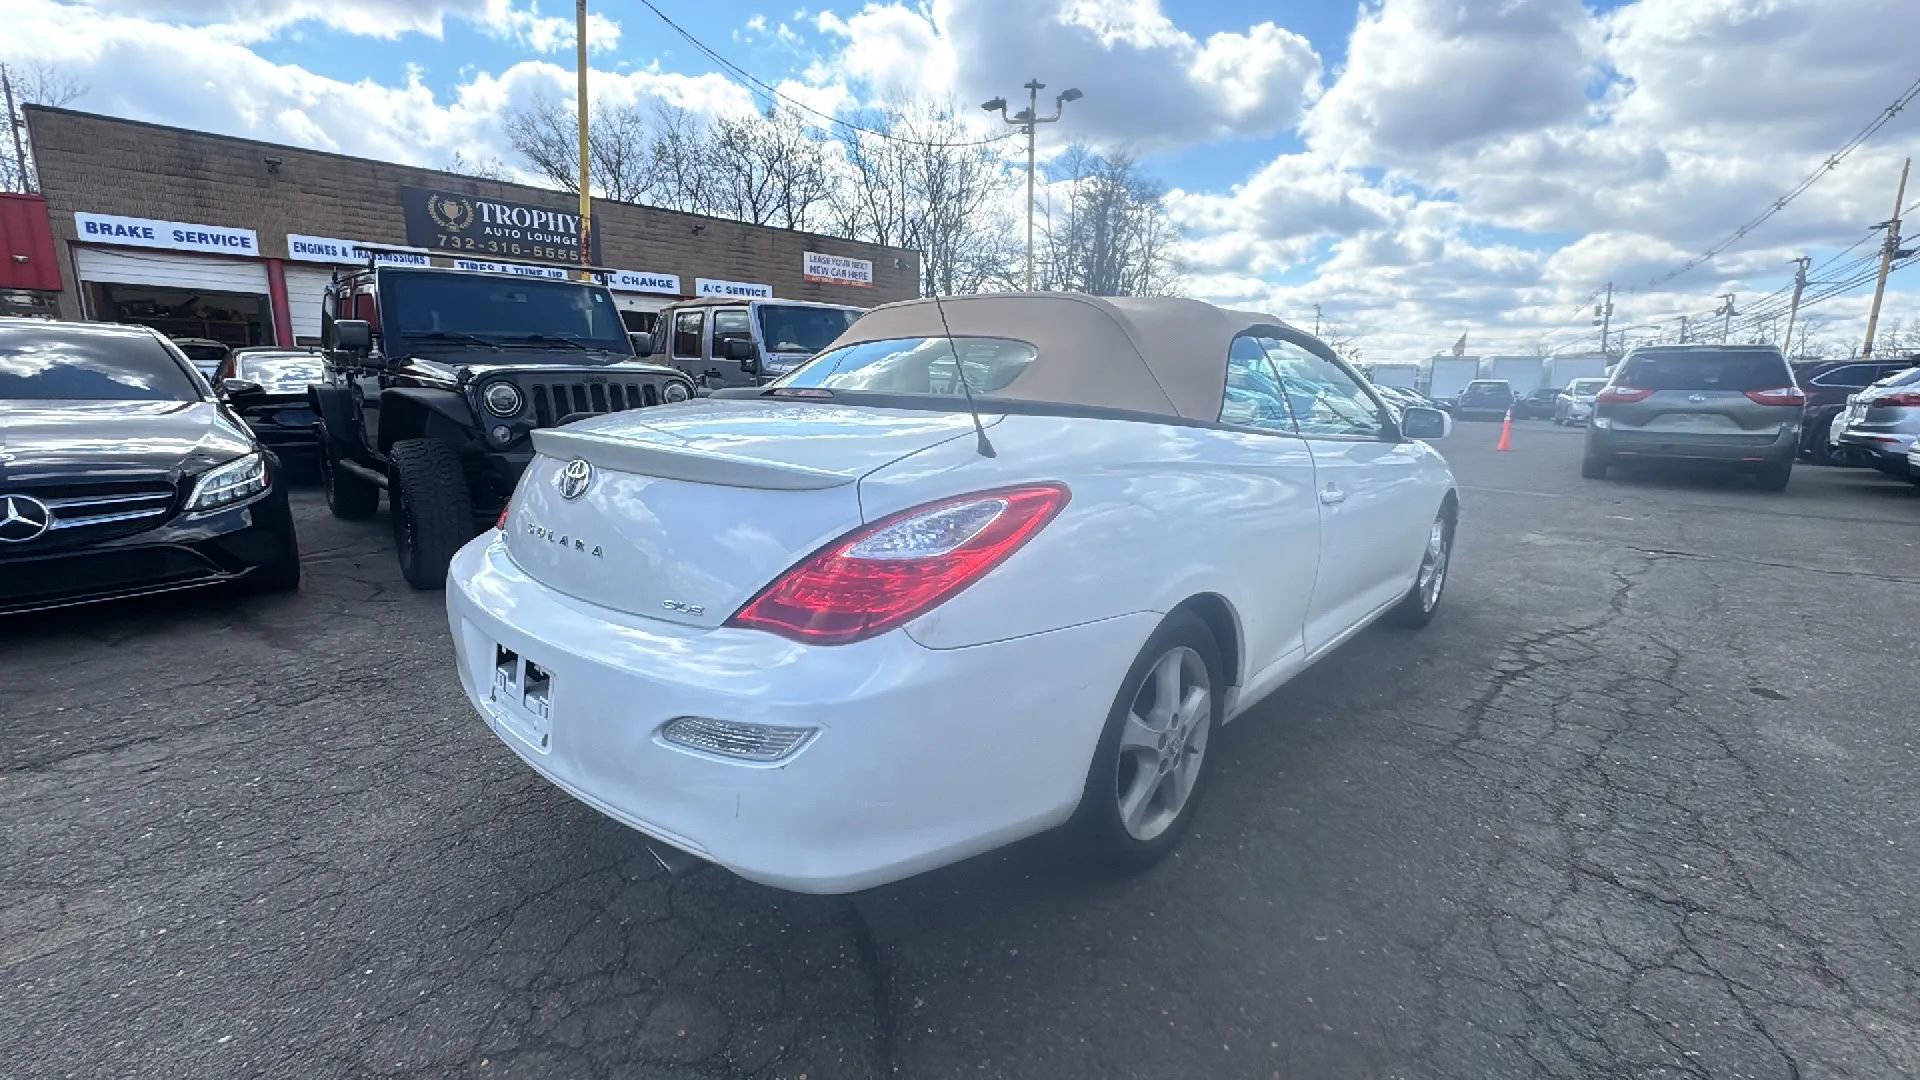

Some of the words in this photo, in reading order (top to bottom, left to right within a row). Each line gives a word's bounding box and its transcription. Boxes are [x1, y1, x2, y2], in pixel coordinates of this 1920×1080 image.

[476, 201, 579, 235] TROPHY
[84, 221, 155, 240] BRAKE
[172, 229, 252, 249] SERVICE
[484, 226, 521, 239] AUTO
[527, 231, 579, 246] LOUNGE
[293, 241, 338, 257] ENGINES
[341, 246, 349, 258] &
[353, 248, 426, 265] TRASMISSIONS
[809, 255, 831, 265] LEASE
[831, 257, 850, 268] YOUR
[851, 260, 868, 270] NEXT
[594, 273, 616, 284] OL
[621, 275, 675, 289] CHANGE
[809, 265, 829, 275] NEW
[830, 267, 847, 278] CAR
[848, 269, 869, 280] HERE
[703, 283, 722, 294] A/C
[726, 286, 767, 298] SERVICE
[527, 523, 604, 560] SOLARA
